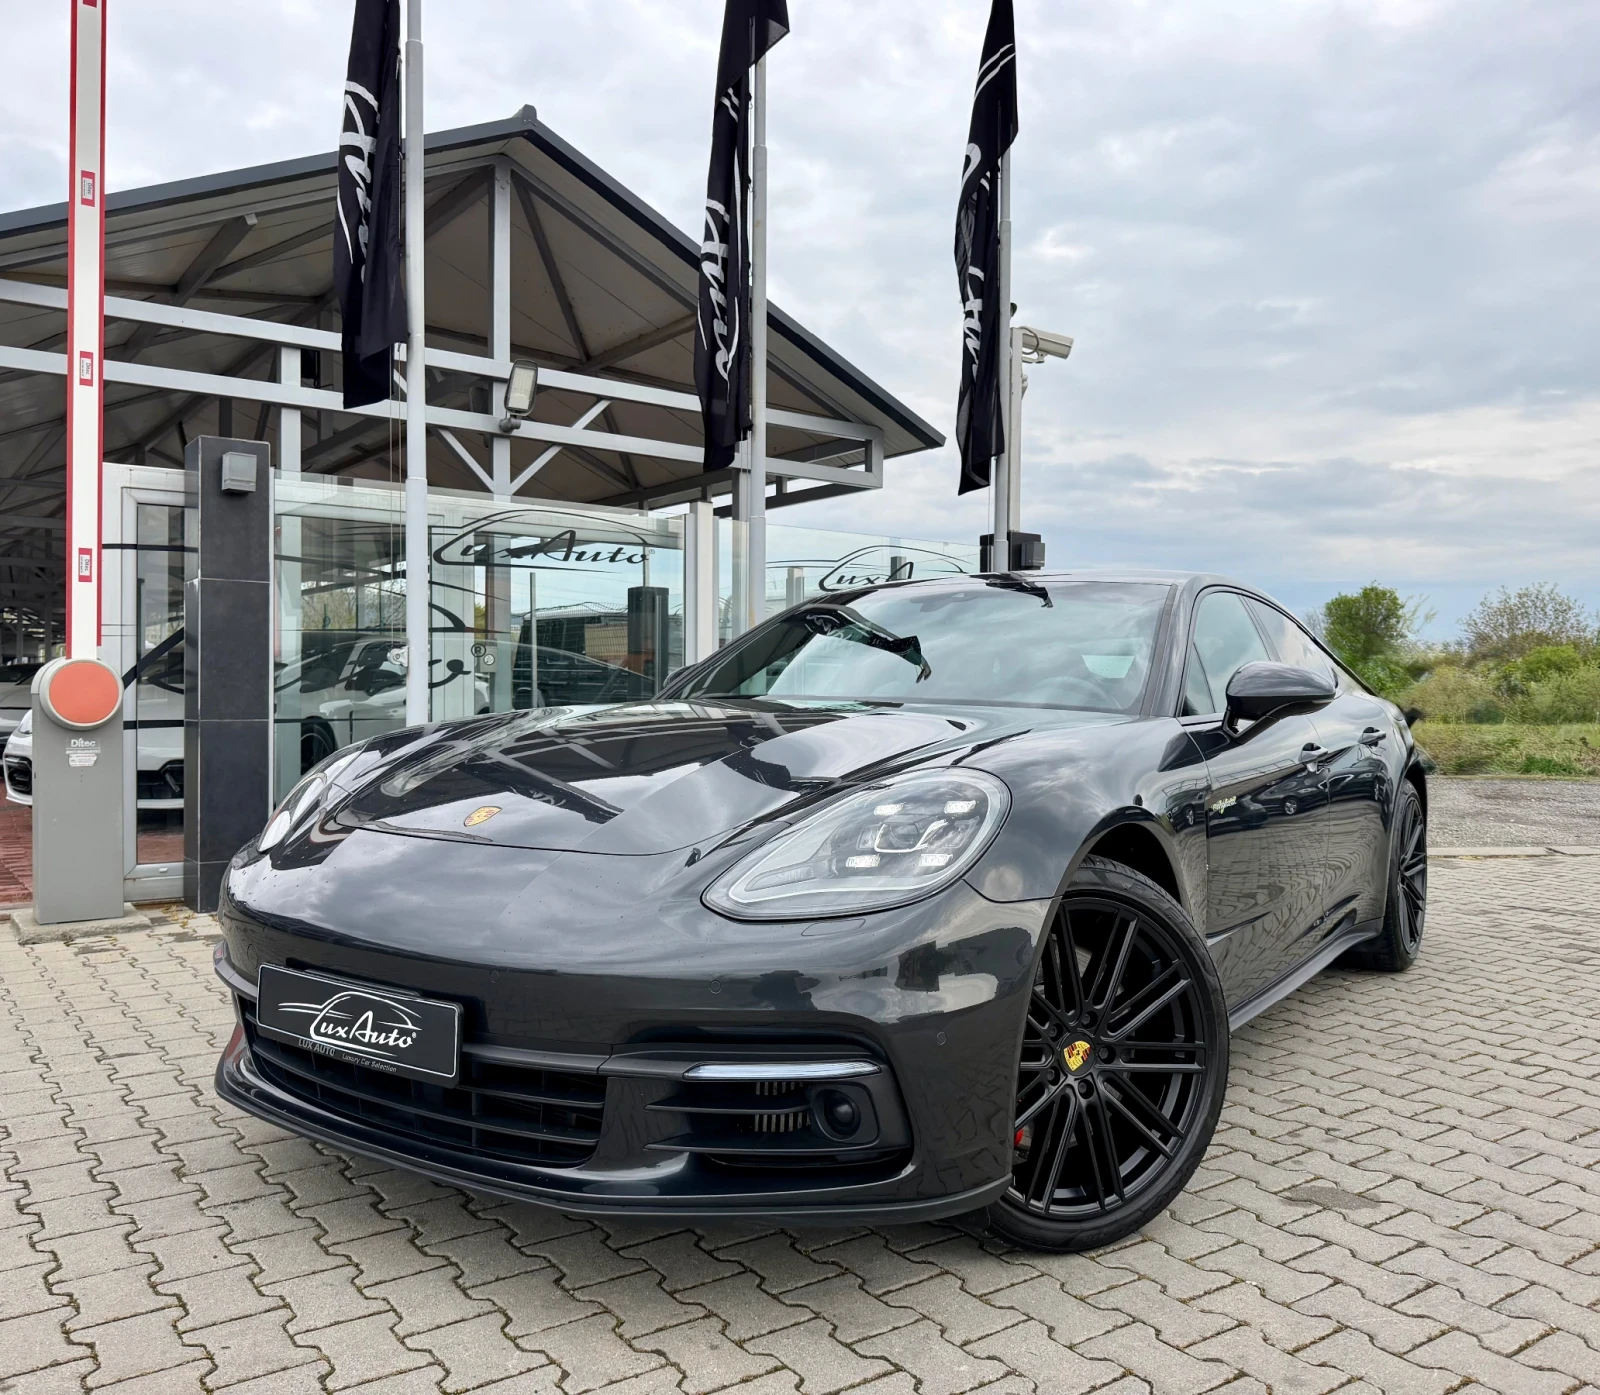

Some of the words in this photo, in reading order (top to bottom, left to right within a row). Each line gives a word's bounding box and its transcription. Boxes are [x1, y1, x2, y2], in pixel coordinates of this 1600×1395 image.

[70, 737, 96, 748] Ditec
[298, 1038, 313, 1050] LUX
[313, 1043, 336, 1057] AUTO
[342, 1053, 360, 1064] Luxury
[371, 1060, 397, 1072] Selection
